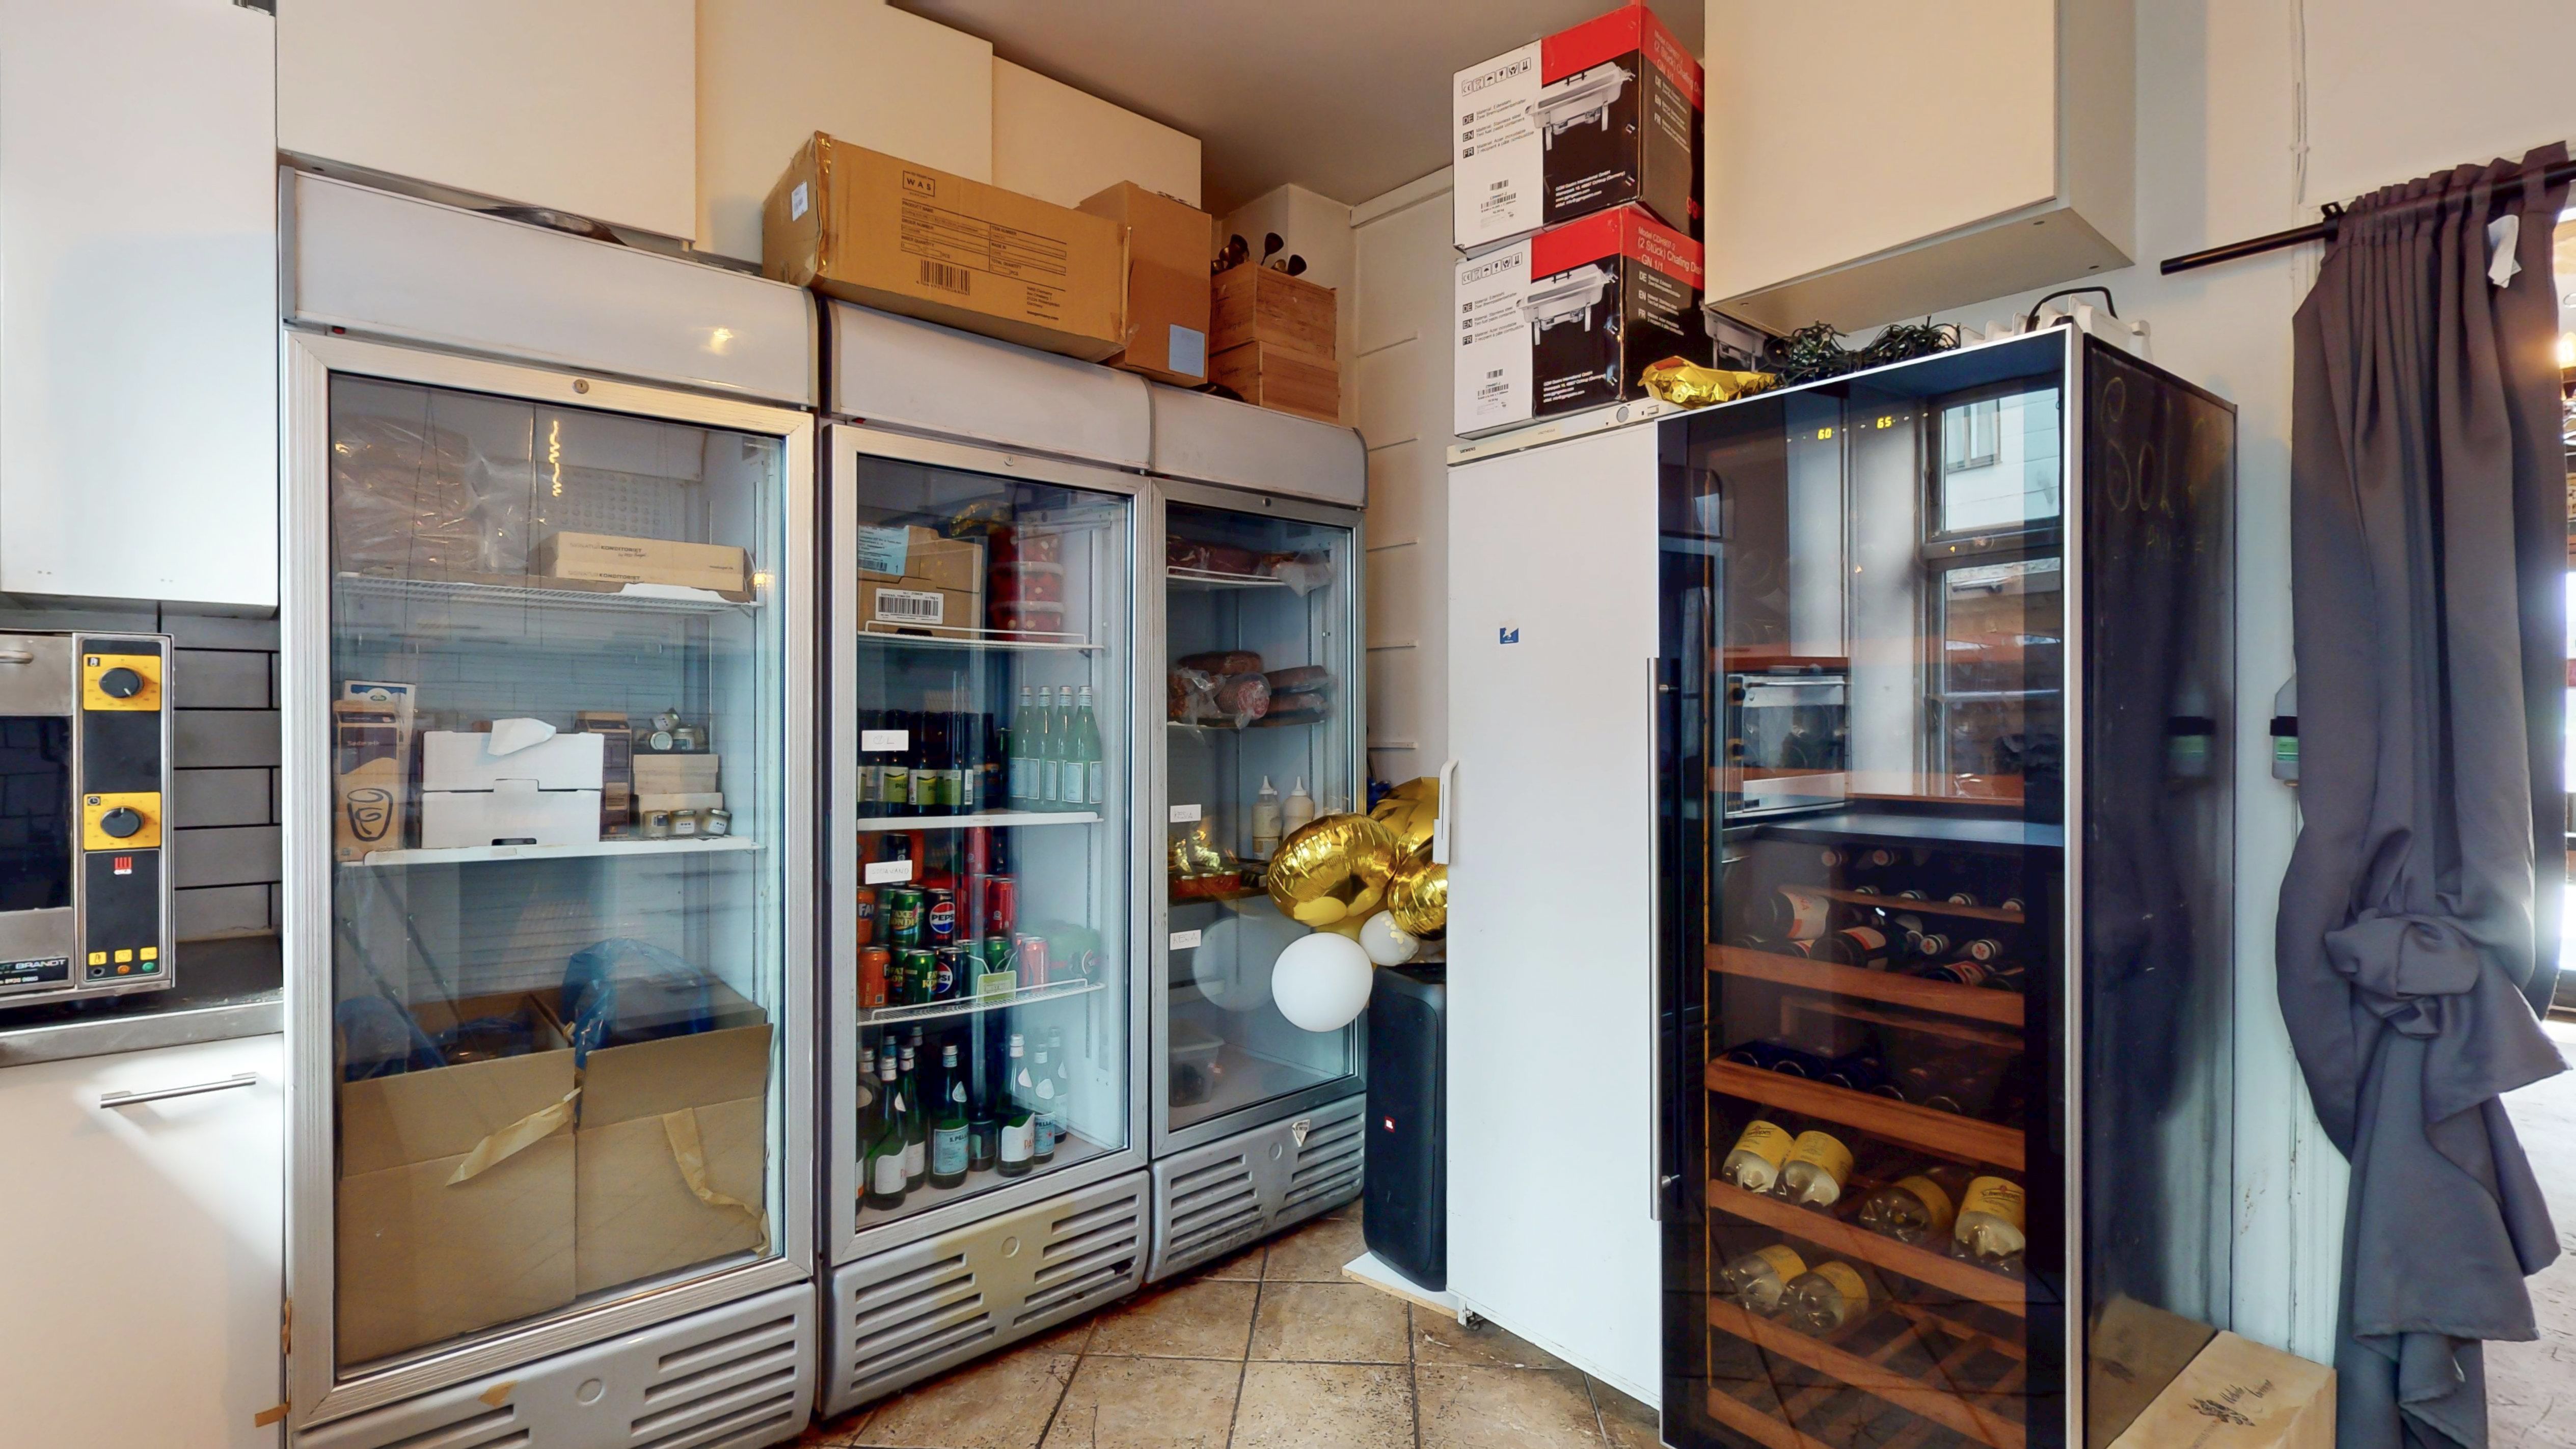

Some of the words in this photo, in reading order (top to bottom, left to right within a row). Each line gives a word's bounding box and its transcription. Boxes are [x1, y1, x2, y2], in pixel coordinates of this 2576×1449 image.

[1463, 113, 1474, 126] DE
[1463, 130, 1474, 142] EN
[1463, 147, 1474, 158] FR
[1641, 254, 1653, 267] GN
[1462, 302, 1472, 313] DE
[1462, 319, 1472, 329] EN
[1462, 335, 1472, 345] FR
[1877, 416, 1892, 429] 65
[1818, 427, 1832, 440] 60
[15, 959, 66, 970] BRANDT
